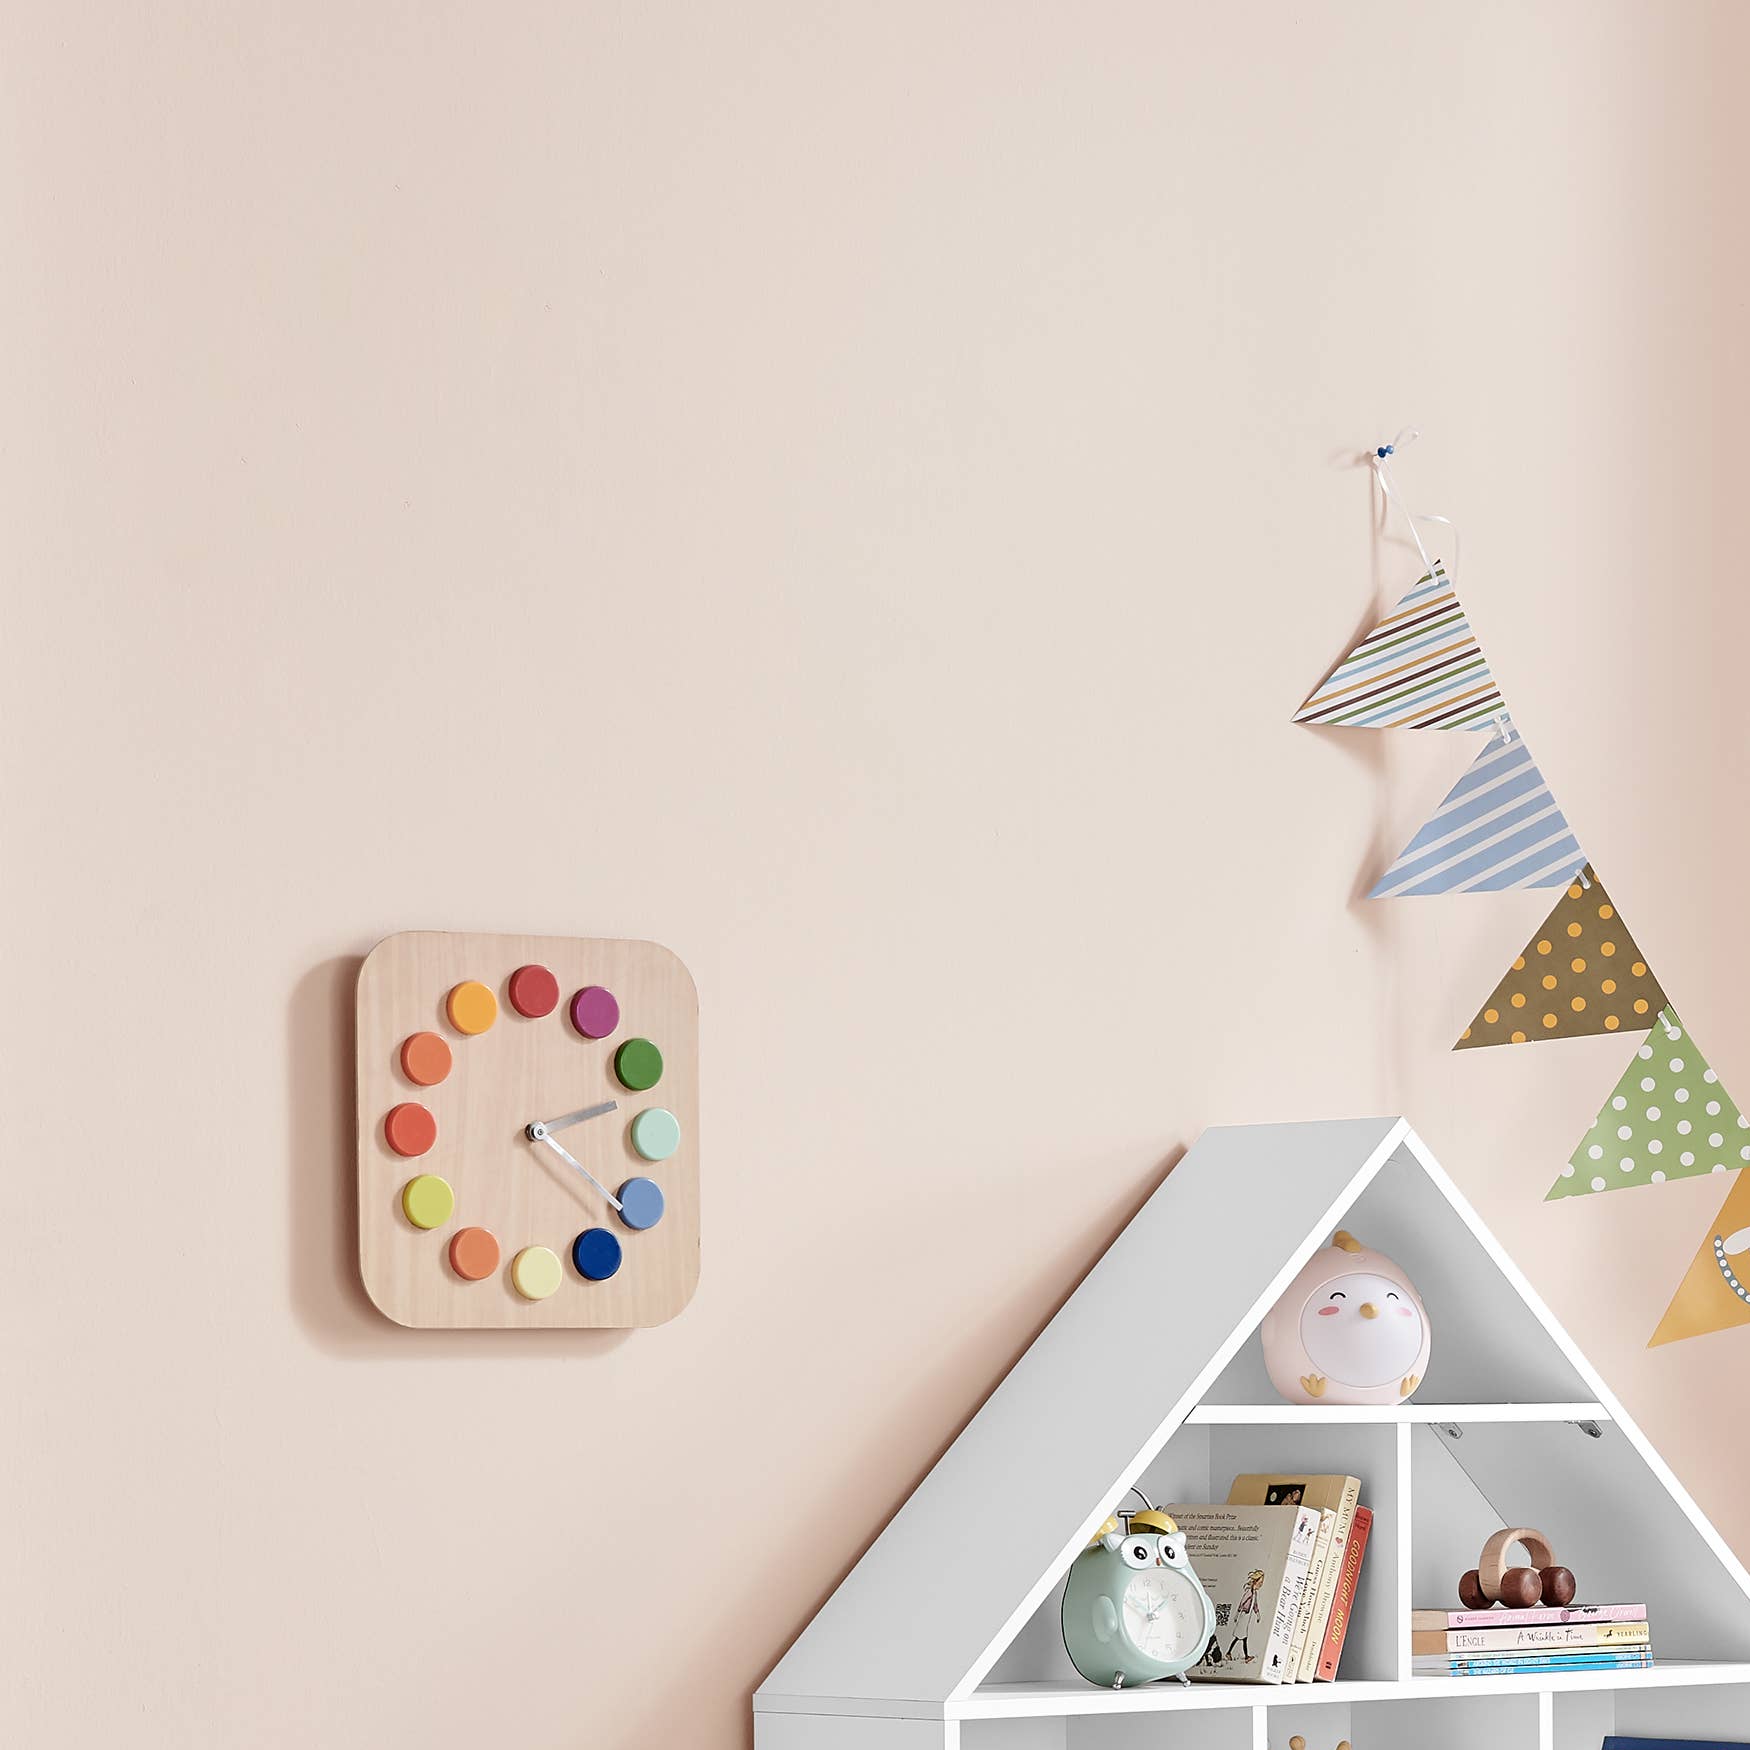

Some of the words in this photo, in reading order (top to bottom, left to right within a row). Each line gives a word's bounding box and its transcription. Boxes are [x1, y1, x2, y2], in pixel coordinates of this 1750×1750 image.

[1340, 1539, 1361, 1610] GOODNIGHT
[1278, 1585, 1292, 1611] Bear
[1272, 1610, 1286, 1638] Hunt
[1282, 1602, 1299, 1632] Going
[1330, 1607, 1346, 1647] MOON
[1455, 1632, 1486, 1648] L'ENGLE
[1564, 1628, 1584, 1643] Time
